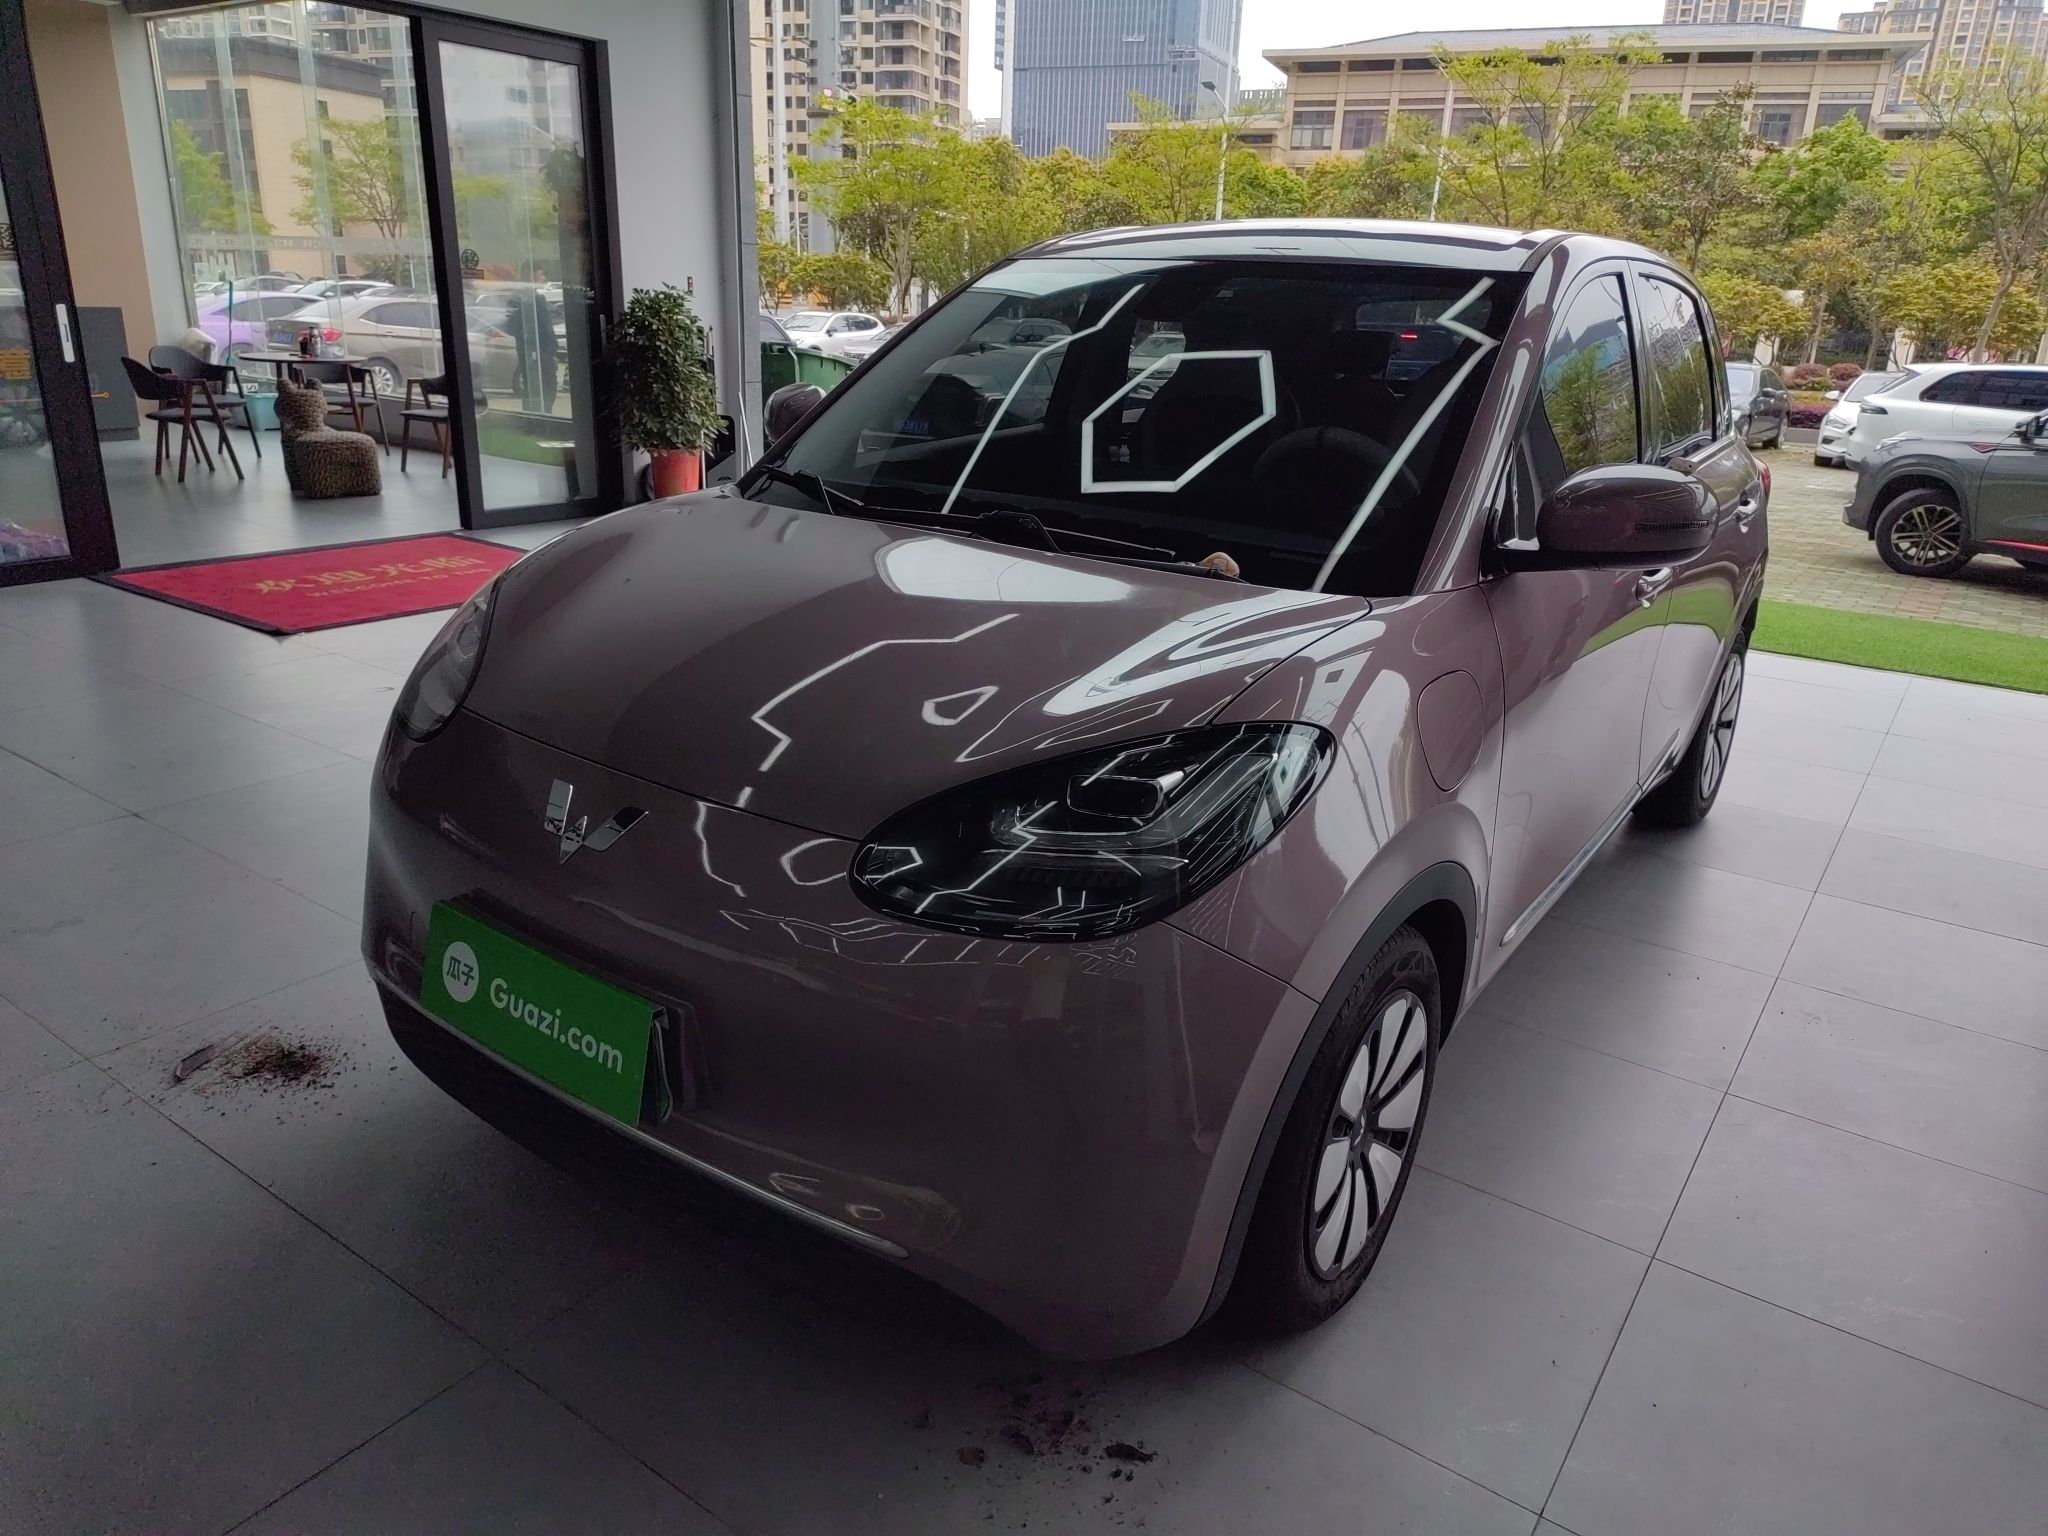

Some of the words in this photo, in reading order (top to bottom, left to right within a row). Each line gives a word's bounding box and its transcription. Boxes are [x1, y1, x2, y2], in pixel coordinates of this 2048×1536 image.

[249, 556, 486, 594] 欢迎光临
[447, 955, 475, 987] 瓜子
[490, 977, 623, 1074] Guazi.com
